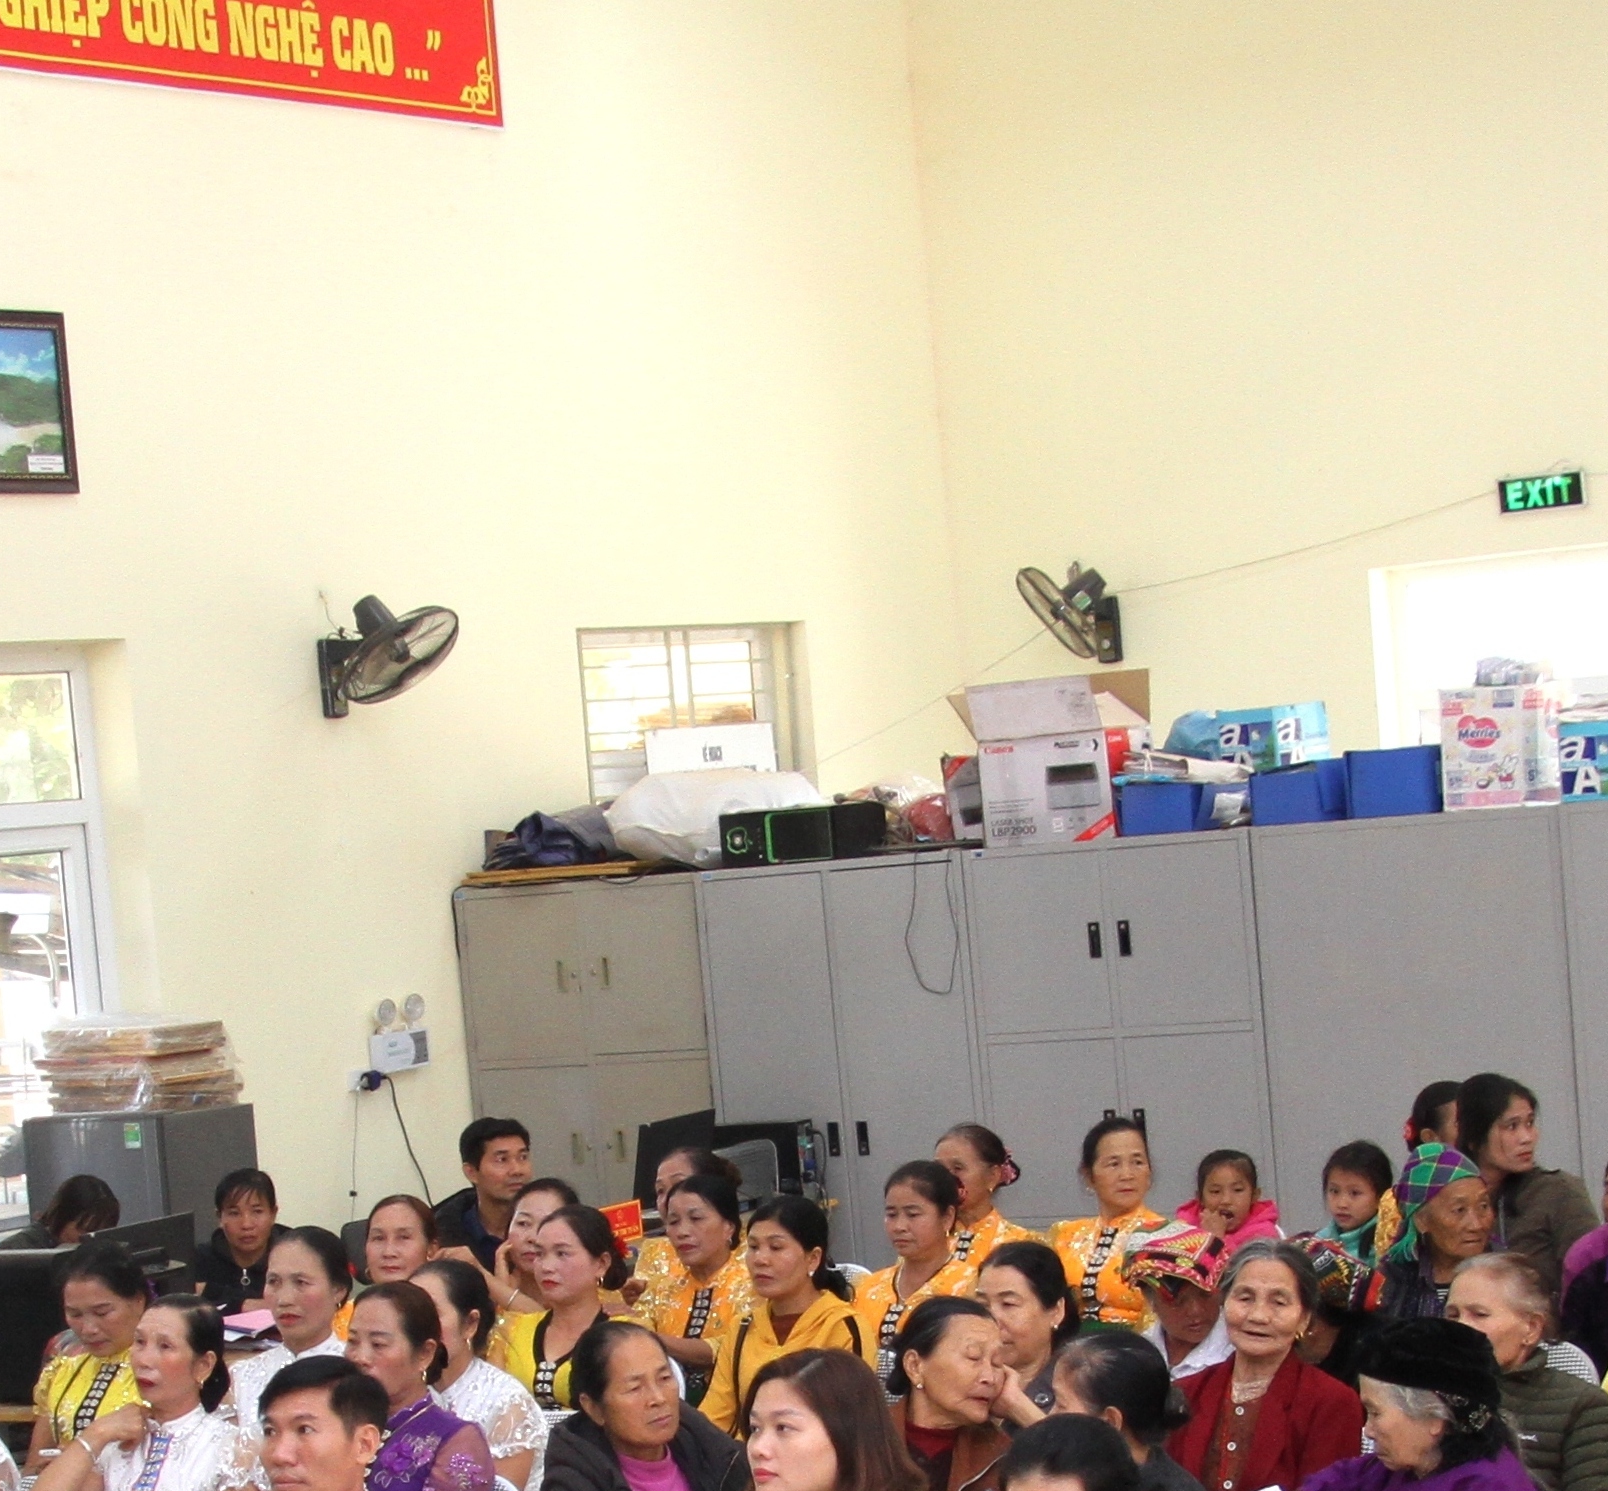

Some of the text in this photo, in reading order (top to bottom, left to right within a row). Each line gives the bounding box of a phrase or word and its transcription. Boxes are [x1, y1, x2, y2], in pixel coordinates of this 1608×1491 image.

[228, 0, 324, 78] NGHỆ
[330, 15, 395, 77] CAO
[1505, 476, 1573, 510] EXIT
[1457, 728, 1501, 742] Merries
[992, 825, 1037, 838] LBP2900
